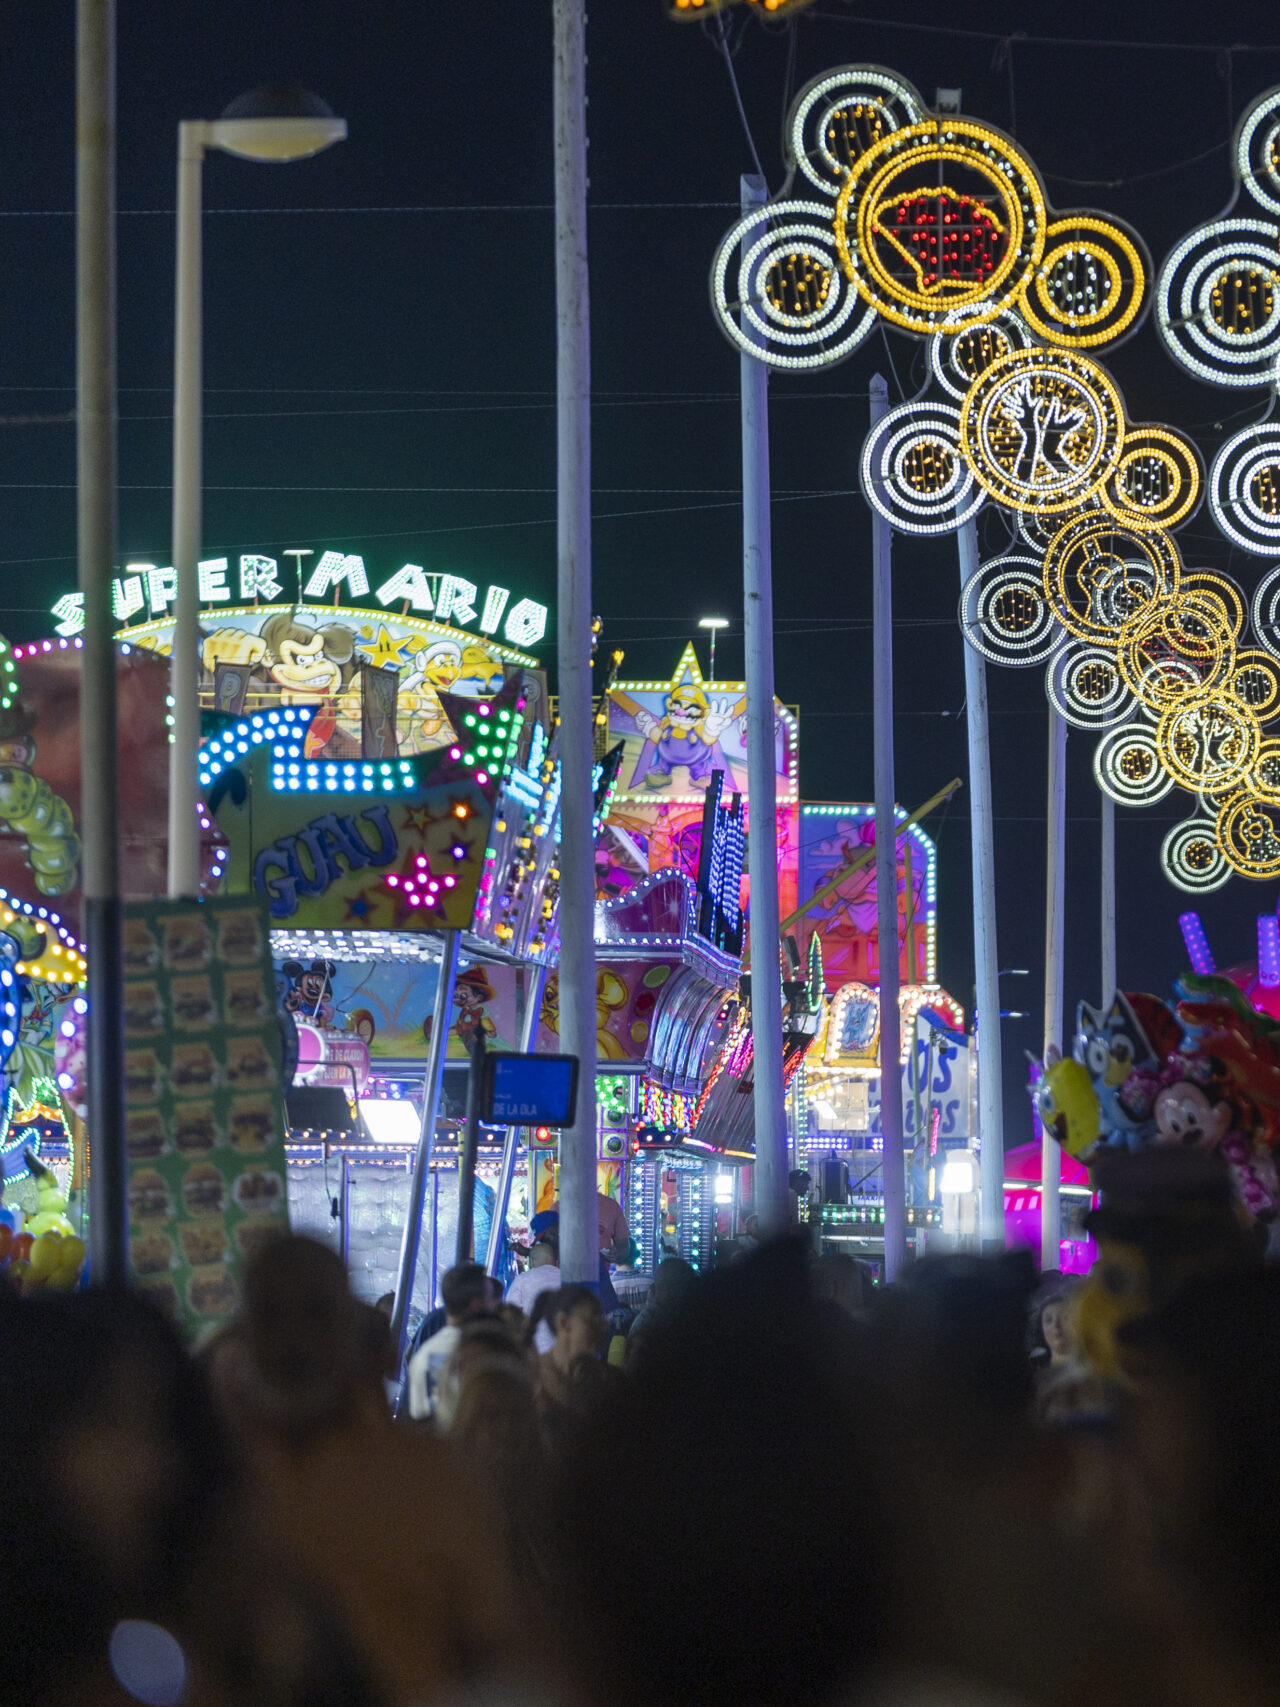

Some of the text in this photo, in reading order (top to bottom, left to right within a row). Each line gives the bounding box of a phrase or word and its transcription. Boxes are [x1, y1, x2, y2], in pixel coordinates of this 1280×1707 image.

[51, 550, 548, 647] SUPER MARIO
[255, 804, 398, 919] GUAU
[494, 1102, 538, 1116] DE LA OLA
